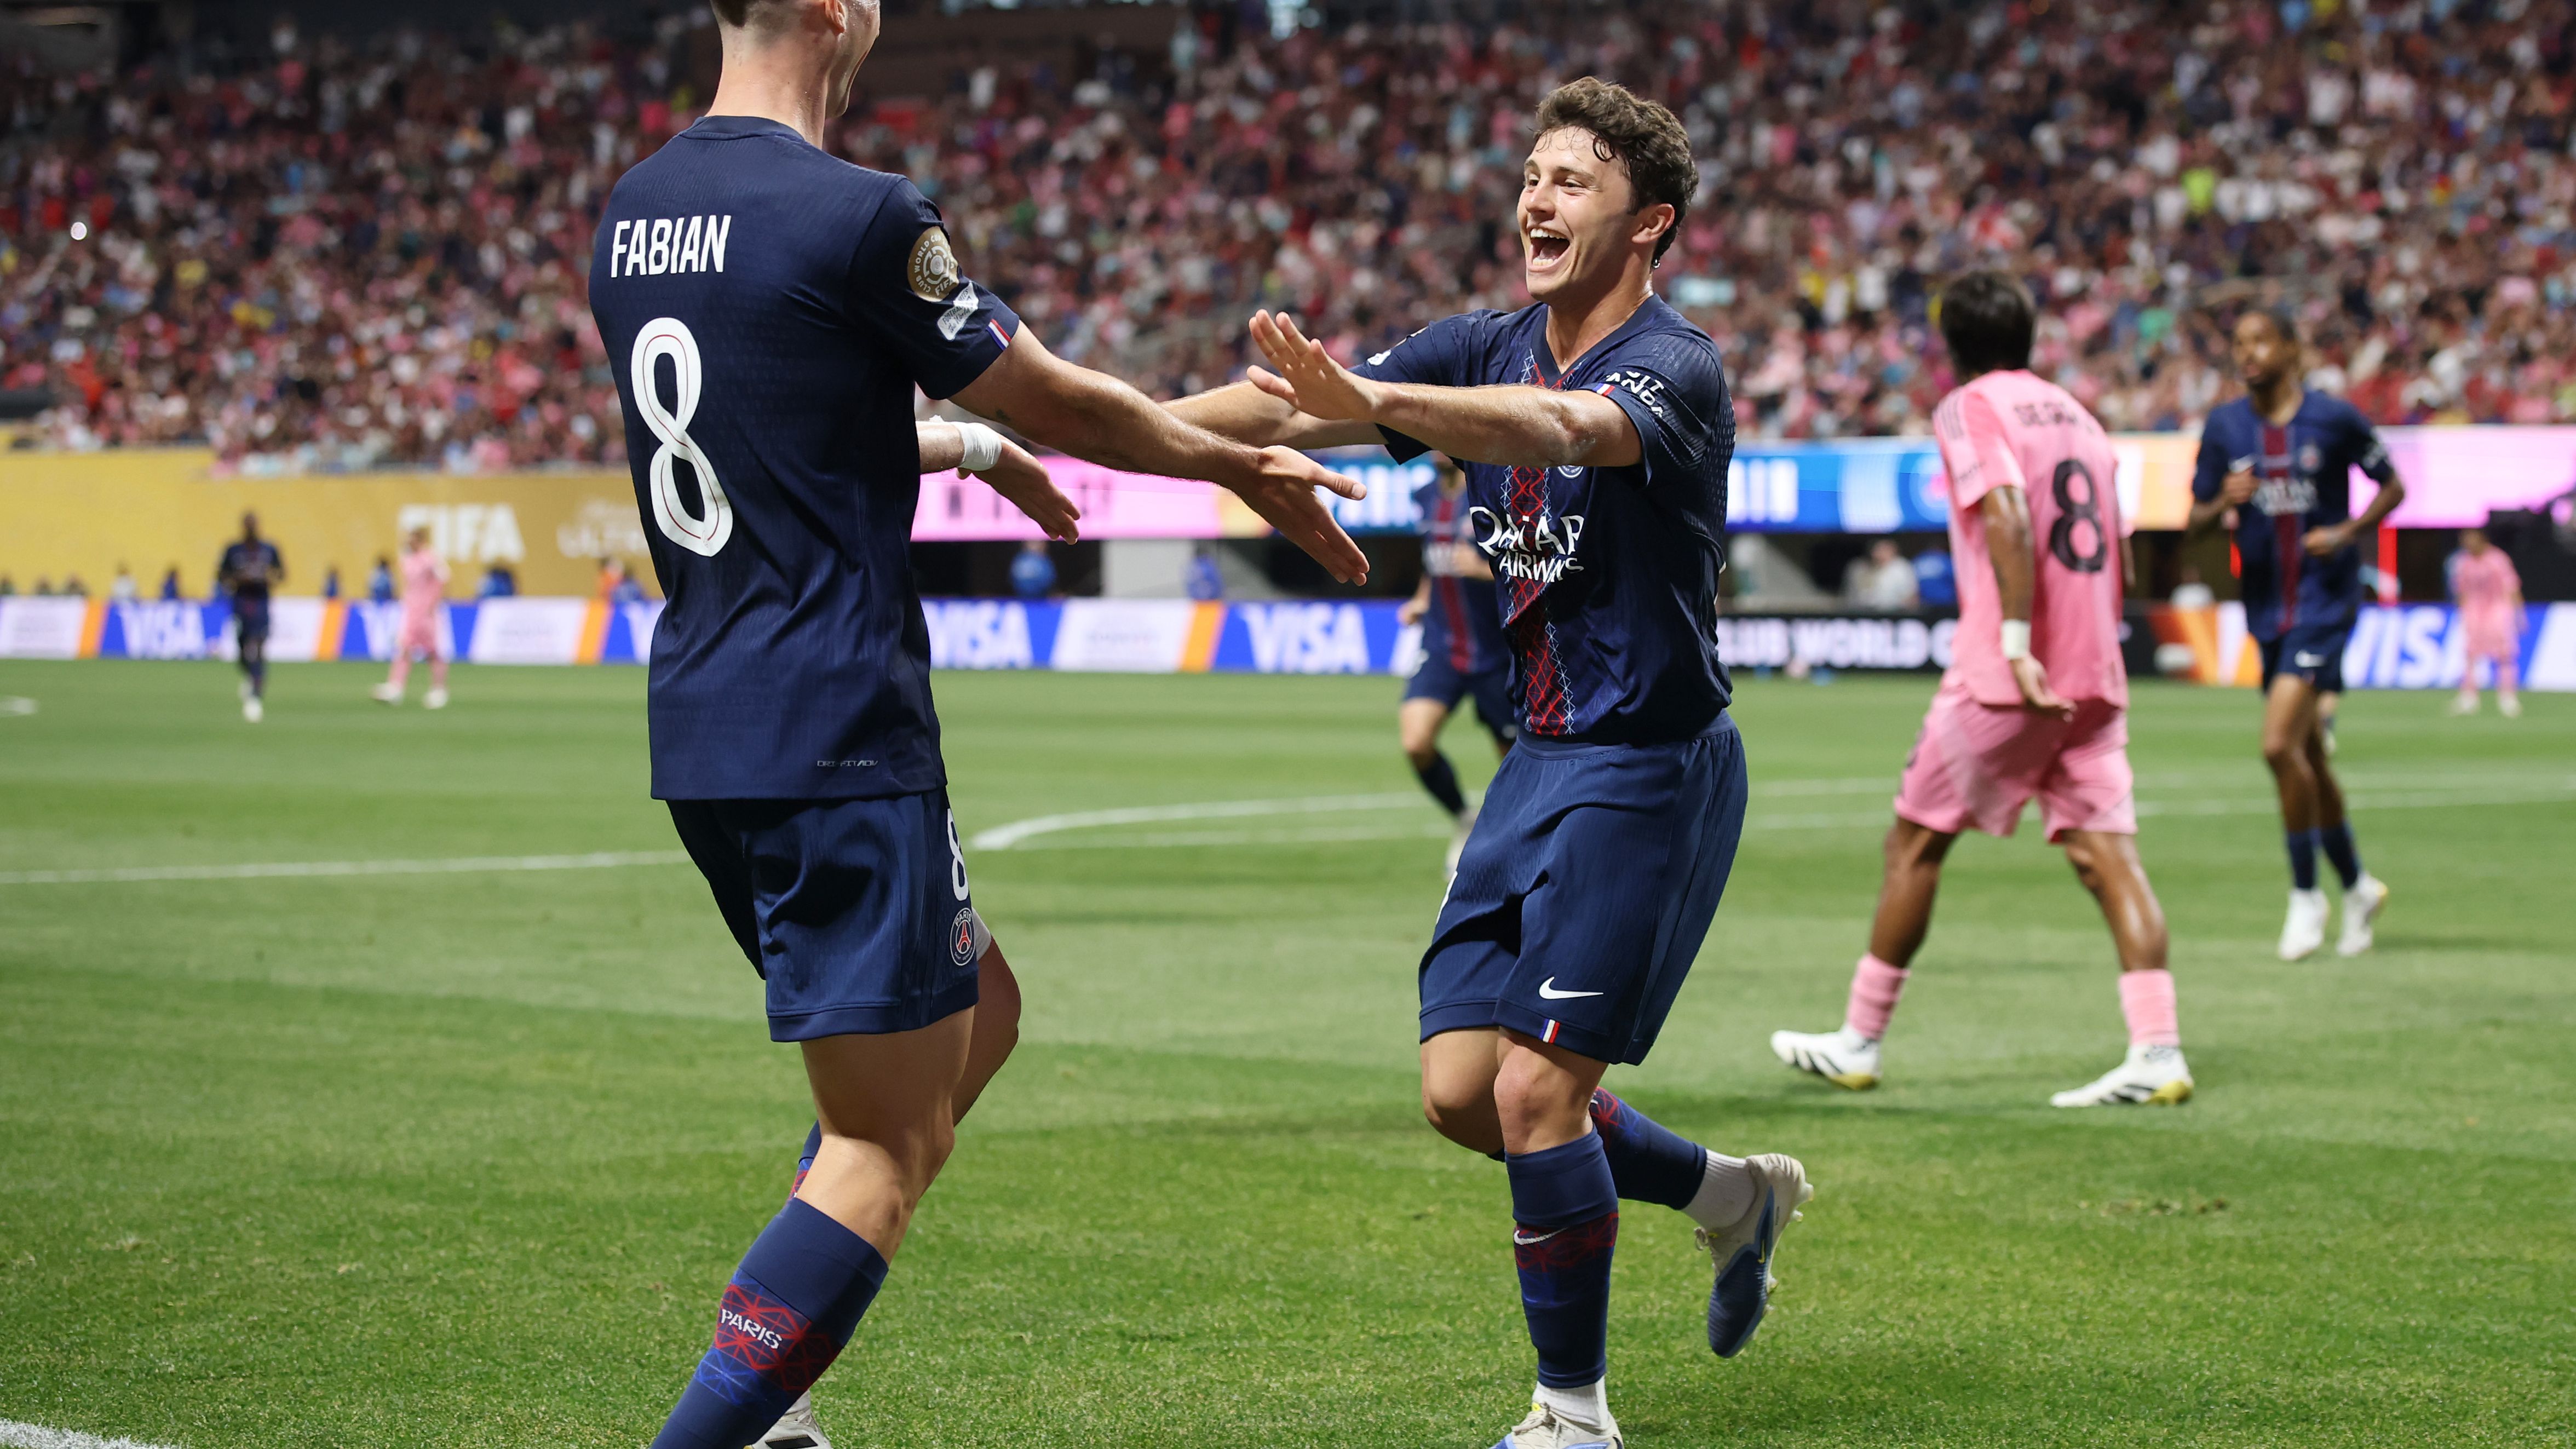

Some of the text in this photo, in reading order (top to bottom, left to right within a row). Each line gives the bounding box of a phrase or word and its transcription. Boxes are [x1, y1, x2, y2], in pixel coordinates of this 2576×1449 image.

[611, 215, 732, 278] FABIAN
[914, 240, 930, 273] WORLD
[916, 275, 932, 293] CLUB
[631, 317, 733, 557] 8
[2050, 458, 2106, 573] 8
[1239, 603, 1370, 674] VISA
[1791, 619, 1929, 666] WORLD
[947, 808, 969, 901] 8
[955, 910, 972, 927] PARIS
[720, 1308, 783, 1349] PARIS
